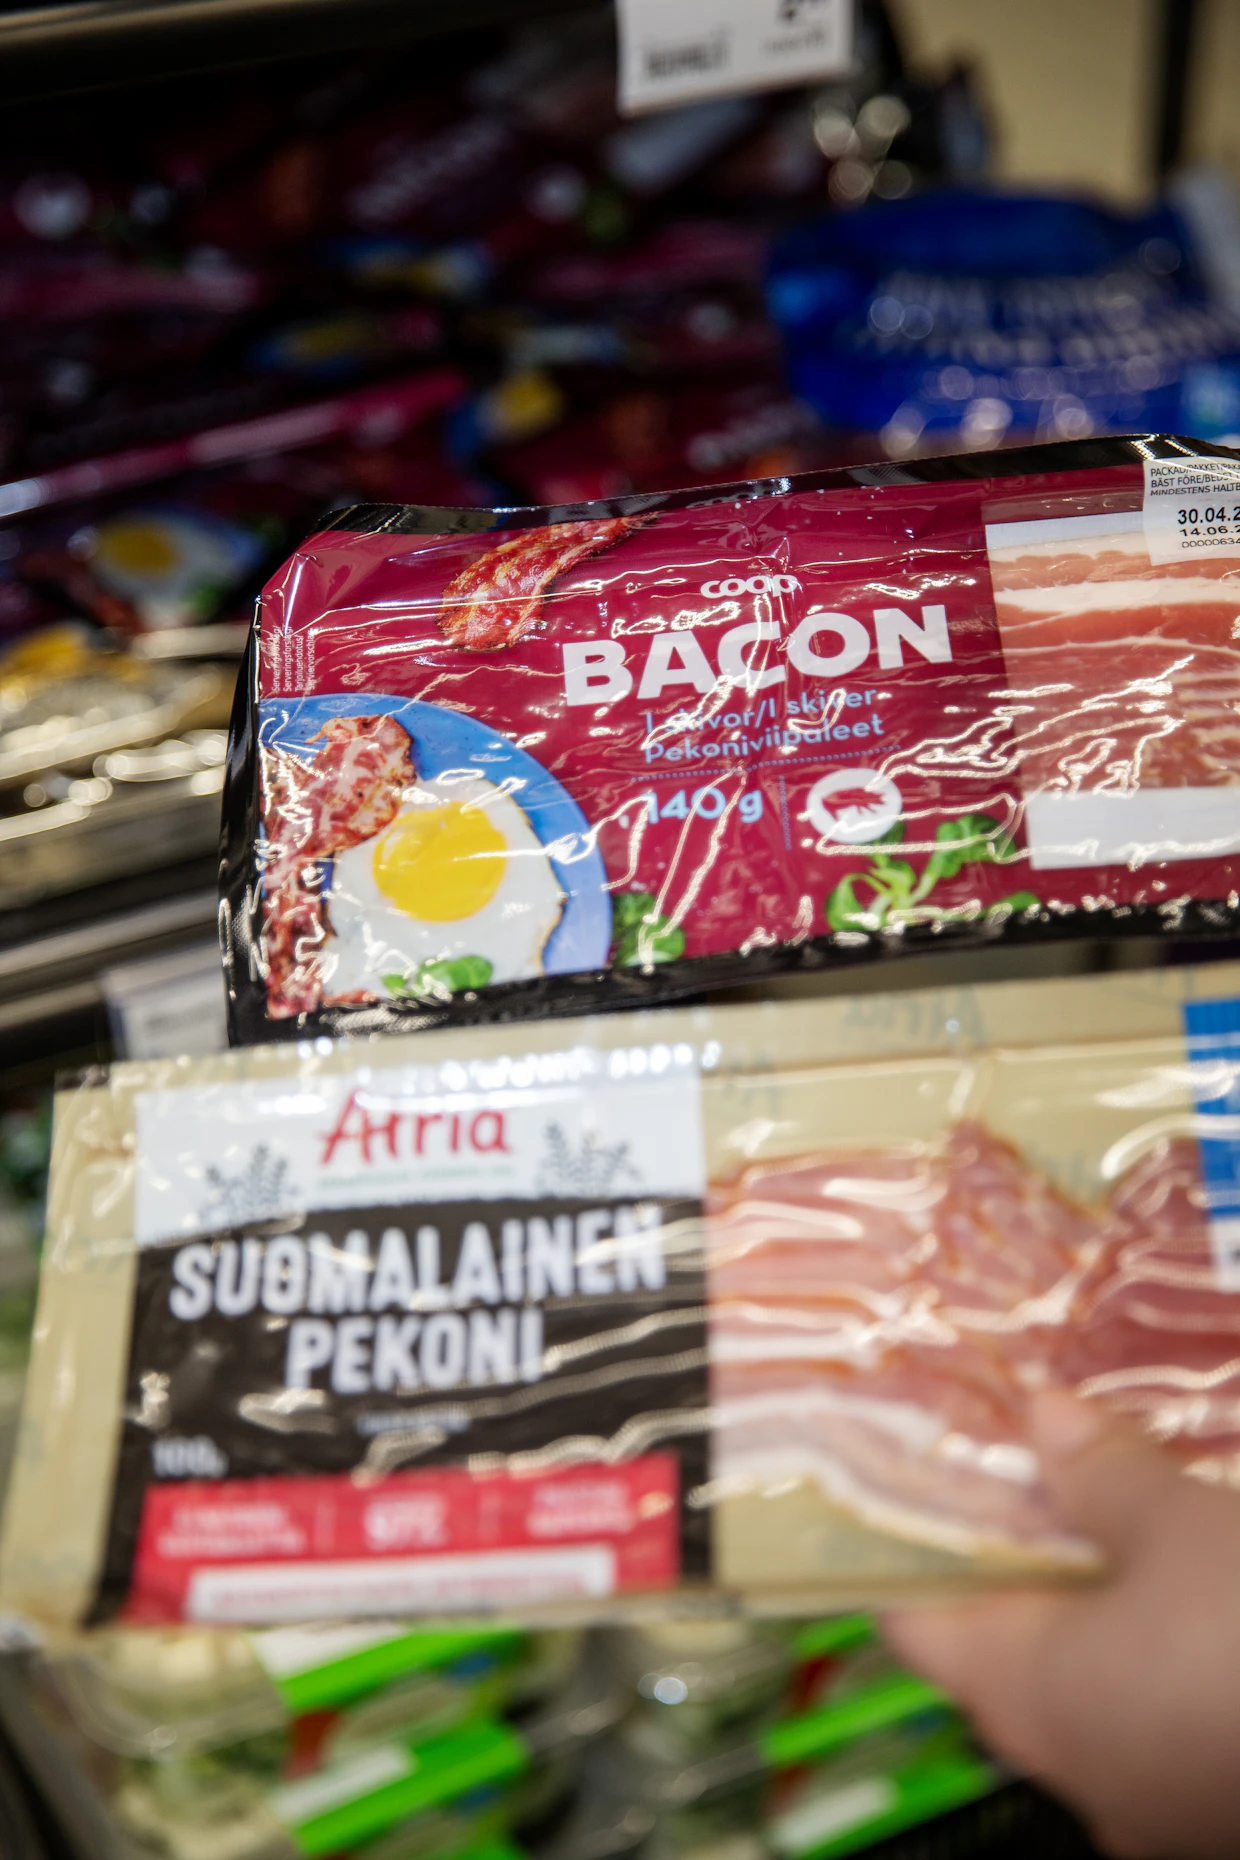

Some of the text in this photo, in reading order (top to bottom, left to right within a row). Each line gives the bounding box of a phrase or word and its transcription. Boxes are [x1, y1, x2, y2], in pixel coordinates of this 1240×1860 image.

[1150, 485, 1210, 496] MINDESTENS
[1151, 477, 1175, 488] BÄST
[700, 574, 799, 598] coop
[561, 603, 953, 706] BACON
[786, 688, 877, 716] skiver
[645, 713, 885, 763] Pekoniviipaleet
[648, 786, 764, 825] 140 g
[318, 1088, 516, 1167] Atria
[168, 1204, 668, 1321] SUOMALAINEN
[284, 1307, 545, 1394] PEKONI
